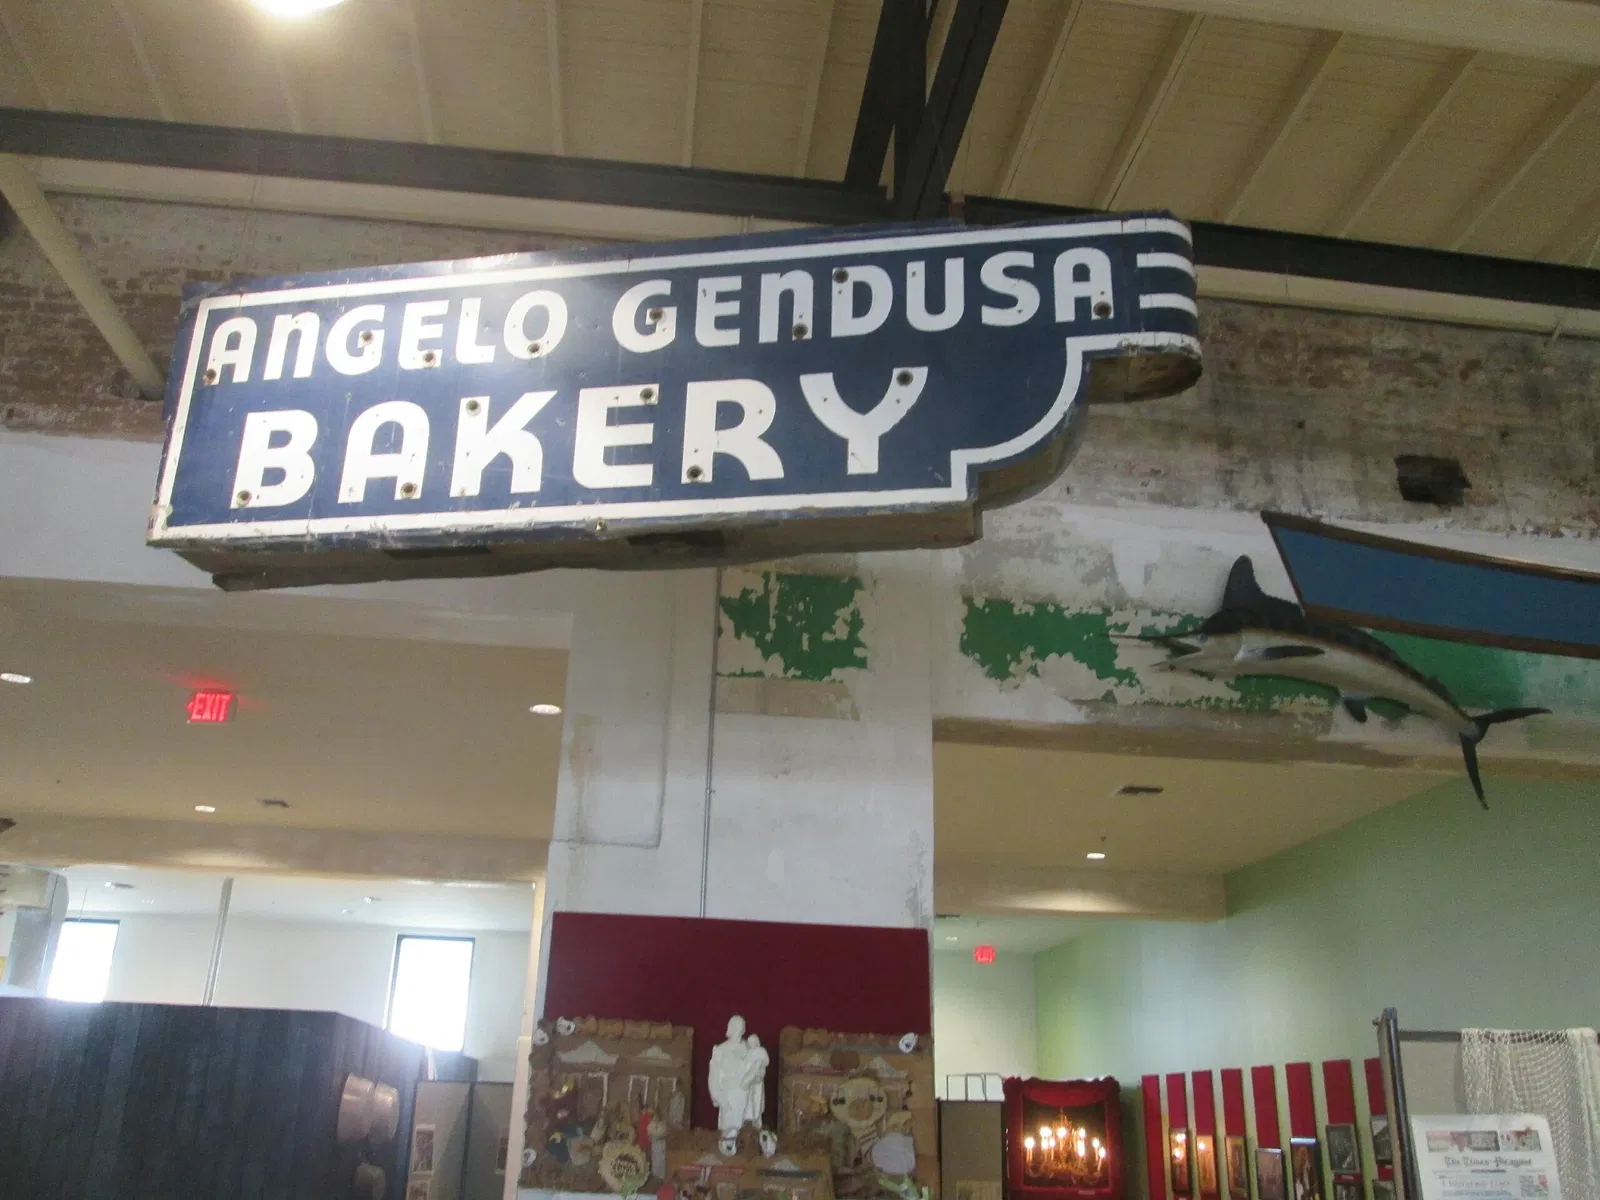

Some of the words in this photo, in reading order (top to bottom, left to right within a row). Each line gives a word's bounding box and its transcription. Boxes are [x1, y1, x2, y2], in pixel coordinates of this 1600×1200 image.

[205, 290, 568, 386] ANGELO
[612, 247, 1114, 354] GENDUSA
[230, 366, 929, 509] BAKERY
[191, 692, 232, 721] EXIT
